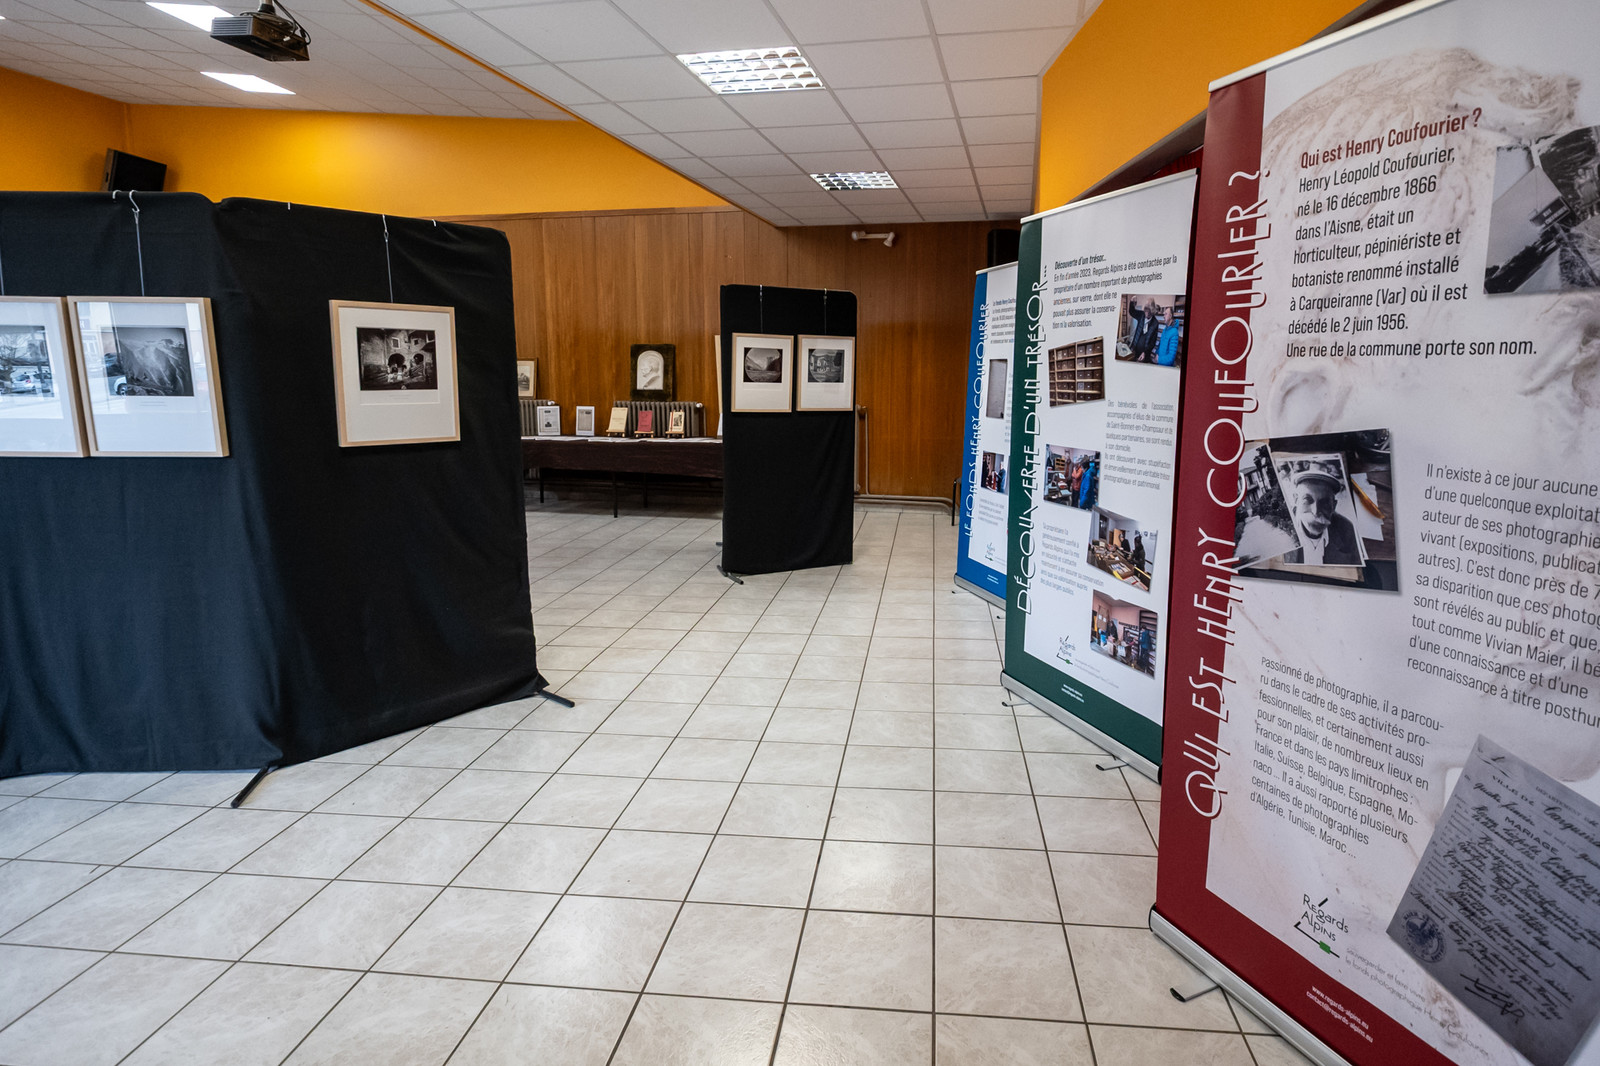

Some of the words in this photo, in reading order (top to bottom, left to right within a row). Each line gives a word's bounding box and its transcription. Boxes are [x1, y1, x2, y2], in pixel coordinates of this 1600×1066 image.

[1301, 149, 1319, 169] Qui
[1322, 144, 1342, 163] est
[1346, 136, 1384, 158] Henry
[1388, 115, 1469, 146] Coufourier
[1473, 107, 1482, 127] ?
[1299, 176, 1330, 193] Henry
[1334, 160, 1380, 186] Léopold
[1383, 147, 1454, 174] Coufourier,
[1296, 200, 1310, 217] né
[1313, 199, 1322, 214] le
[1326, 195, 1338, 211] 16
[1341, 186, 1400, 209] décembre
[1404, 175, 1437, 196] 1866
[1294, 244, 1361, 264] horticulteur,
[1364, 232, 1441, 258] pépiniériste
[1446, 228, 1461, 245] et
[1296, 226, 1320, 240] dans
[1324, 220, 1363, 236] l'Aisne,
[1367, 210, 1395, 229] était
[1398, 210, 1414, 224] un
[1055, 259, 1077, 270] Découverte
[1078, 256, 1088, 265] d'un
[1093, 266, 1109, 276] Regards
[1110, 264, 1123, 273] Alpins
[1128, 261, 1136, 270] été
[1137, 257, 1162, 269] contactée
[1163, 257, 1171, 266] par
[1173, 254, 1177, 263] la
[1121, 276, 1127, 284] de
[1128, 272, 1162, 285] photographies
[1292, 270, 1344, 288] botaniste
[1347, 261, 1402, 282] renommé
[1406, 255, 1459, 276] installé
[1290, 297, 1296, 311] à
[1299, 293, 1373, 312] Carqueiranne
[1376, 287, 1406, 307] (Var)
[1410, 285, 1427, 302] où
[1432, 284, 1440, 301] il
[1444, 283, 1468, 300] est
[1288, 318, 1327, 334] décédé
[1330, 318, 1340, 332] le
[1343, 316, 1350, 332] 2
[1352, 316, 1373, 335] juin
[1377, 313, 1408, 330] 1956.
[974, 303, 990, 410] COUFOURIER
[1204, 198, 1271, 507] COUFOURIER
[1287, 343, 1306, 357] Une
[1309, 346, 1327, 357] rue
[1330, 341, 1344, 357] de
[1347, 342, 1356, 356] la
[1359, 343, 1421, 356] commune
[1425, 340, 1465, 359] porte
[1469, 342, 1494, 355] son
[1499, 341, 1536, 355] nom.
[1024, 379, 1042, 436] D'UN
[968, 415, 982, 457] HENRY
[965, 462, 979, 520] FONDS
[1425, 486, 1457, 502] d'une
[1460, 492, 1531, 514] quelconque
[1427, 464, 1433, 477] Il
[1436, 465, 1481, 483] n'existe
[1484, 470, 1492, 484] à
[1495, 474, 1510, 486] ce
[1512, 473, 1540, 490] jour
[1542, 480, 1598, 497] aucune
[964, 522, 974, 537] LE
[1014, 444, 1041, 615] DÉCOUVERTE
[1422, 510, 1462, 526] auteur
[1464, 514, 1479, 529] de
[1482, 520, 1502, 533] ses
[1421, 530, 1456, 548] vivant
[1459, 535, 1537, 565] (expositions,
[1193, 527, 1244, 646] HENRY
[1416, 575, 1429, 586] sa
[1432, 576, 1493, 602] disparition
[1497, 593, 1520, 608] que
[1524, 600, 1549, 615] ces
[1418, 554, 1462, 572] autres).
[1467, 559, 1495, 579] C'est
[1498, 567, 1530, 586] donc
[1534, 577, 1565, 594] près
[1570, 580, 1588, 598] de
[1414, 596, 1439, 611] sont
[1442, 601, 1484, 622] révélés
[1487, 614, 1502, 627] au
[1505, 618, 1546, 638] public
[1550, 628, 1565, 644] et
[1412, 614, 1436, 632] tout
[1439, 624, 1481, 644] comme
[1486, 632, 1522, 656] Vivian
[1526, 640, 1566, 670] Maier,
[1572, 656, 1579, 672] il
[1408, 658, 1497, 696] reconnaissance
[1500, 685, 1508, 699] à
[1513, 689, 1540, 710] titre
[1410, 635, 1440, 654] d'une
[1443, 647, 1526, 681] connaissance
[1530, 673, 1544, 688] et
[1548, 676, 1588, 699] d'une
[1188, 657, 1236, 723] EST
[1260, 675, 1268, 685] ru
[1271, 677, 1290, 694] dans
[1292, 684, 1300, 697] le
[1302, 691, 1325, 708] cadre
[1327, 700, 1338, 714] de
[1340, 707, 1356, 721] ses
[1358, 715, 1404, 738] activités
[1407, 732, 1430, 746] pro-
[1262, 657, 1302, 680] Passionné
[1304, 672, 1314, 684] de
[1316, 677, 1379, 711] photographie,
[1383, 700, 1389, 712] il
[1391, 706, 1398, 716] a
[1401, 709, 1444, 730] parcou-
[1257, 709, 1275, 722] pour
[1278, 718, 1292, 730] son
[1294, 724, 1319, 744] plaisir,
[1322, 736, 1332, 750] de
[1334, 744, 1384, 772] nombreux
[1388, 762, 1412, 784] lieux
[1416, 777, 1428, 790] en
[1259, 689, 1313, 723] fessionnelles,
[1316, 716, 1324, 727] et
[1326, 721, 1392, 755] certainement
[1395, 748, 1424, 767] aussi
[1183, 733, 1231, 819] QUI
[1505, 816, 1559, 855] MARIAGE
